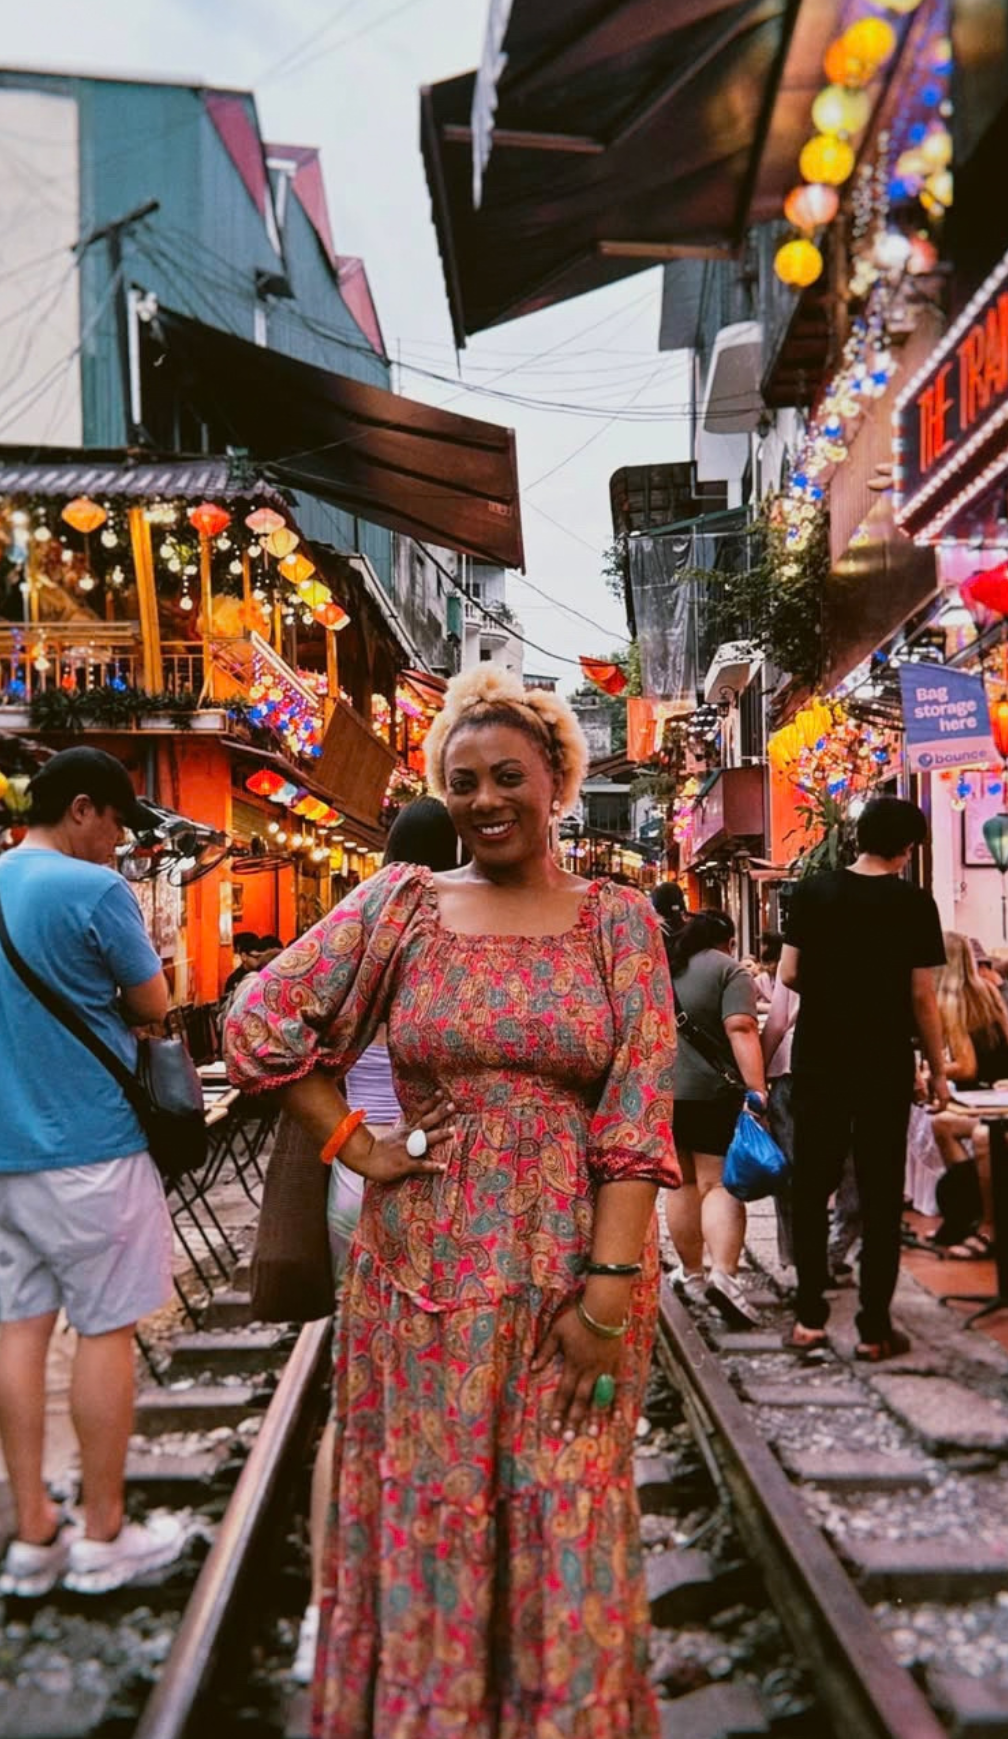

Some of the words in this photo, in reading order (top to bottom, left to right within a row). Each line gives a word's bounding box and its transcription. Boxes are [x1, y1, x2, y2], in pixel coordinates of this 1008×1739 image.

[917, 362, 954, 473] THE
[915, 687, 949, 702] Bag
[914, 700, 977, 718] storage
[940, 717, 977, 731] here
[935, 750, 987, 764] bounce
